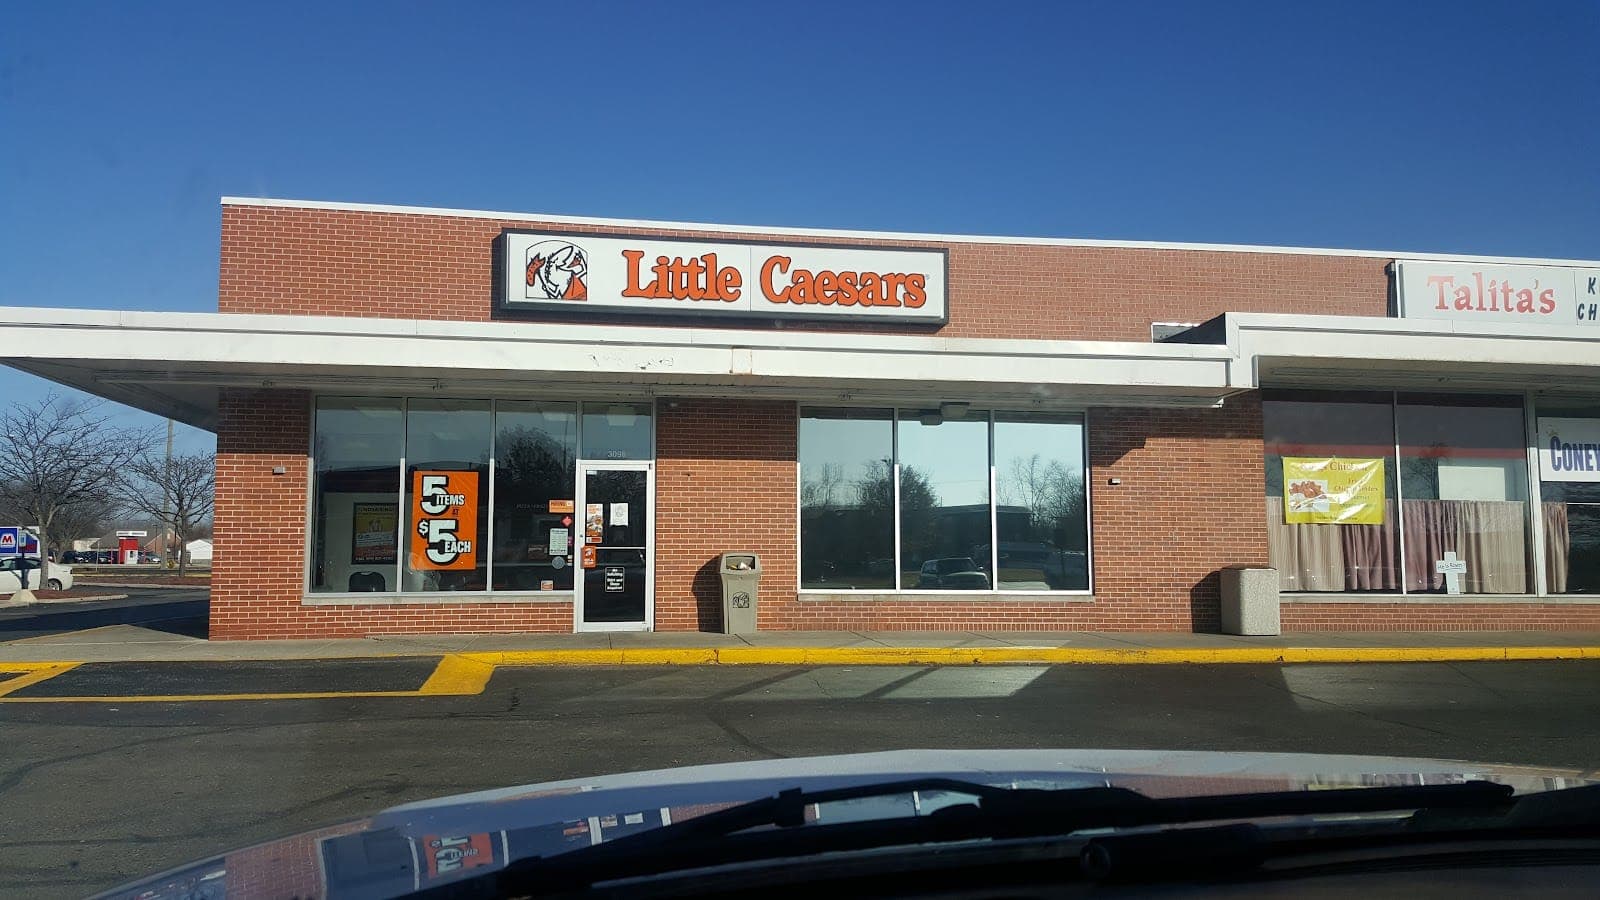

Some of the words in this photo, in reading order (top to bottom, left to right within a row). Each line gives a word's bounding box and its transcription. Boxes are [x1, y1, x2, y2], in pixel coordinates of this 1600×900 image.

[621, 249, 742, 301] Little
[760, 255, 927, 308] Caesars
[1427, 272, 1556, 314] Talita's
[1588, 277, 1600, 295] K
[1550, 435, 1600, 472] CONEY
[421, 475, 448, 515] 5
[435, 494, 465, 506] ITEMS
[417, 519, 457, 564] $5
[444, 541, 472, 554] EACH
